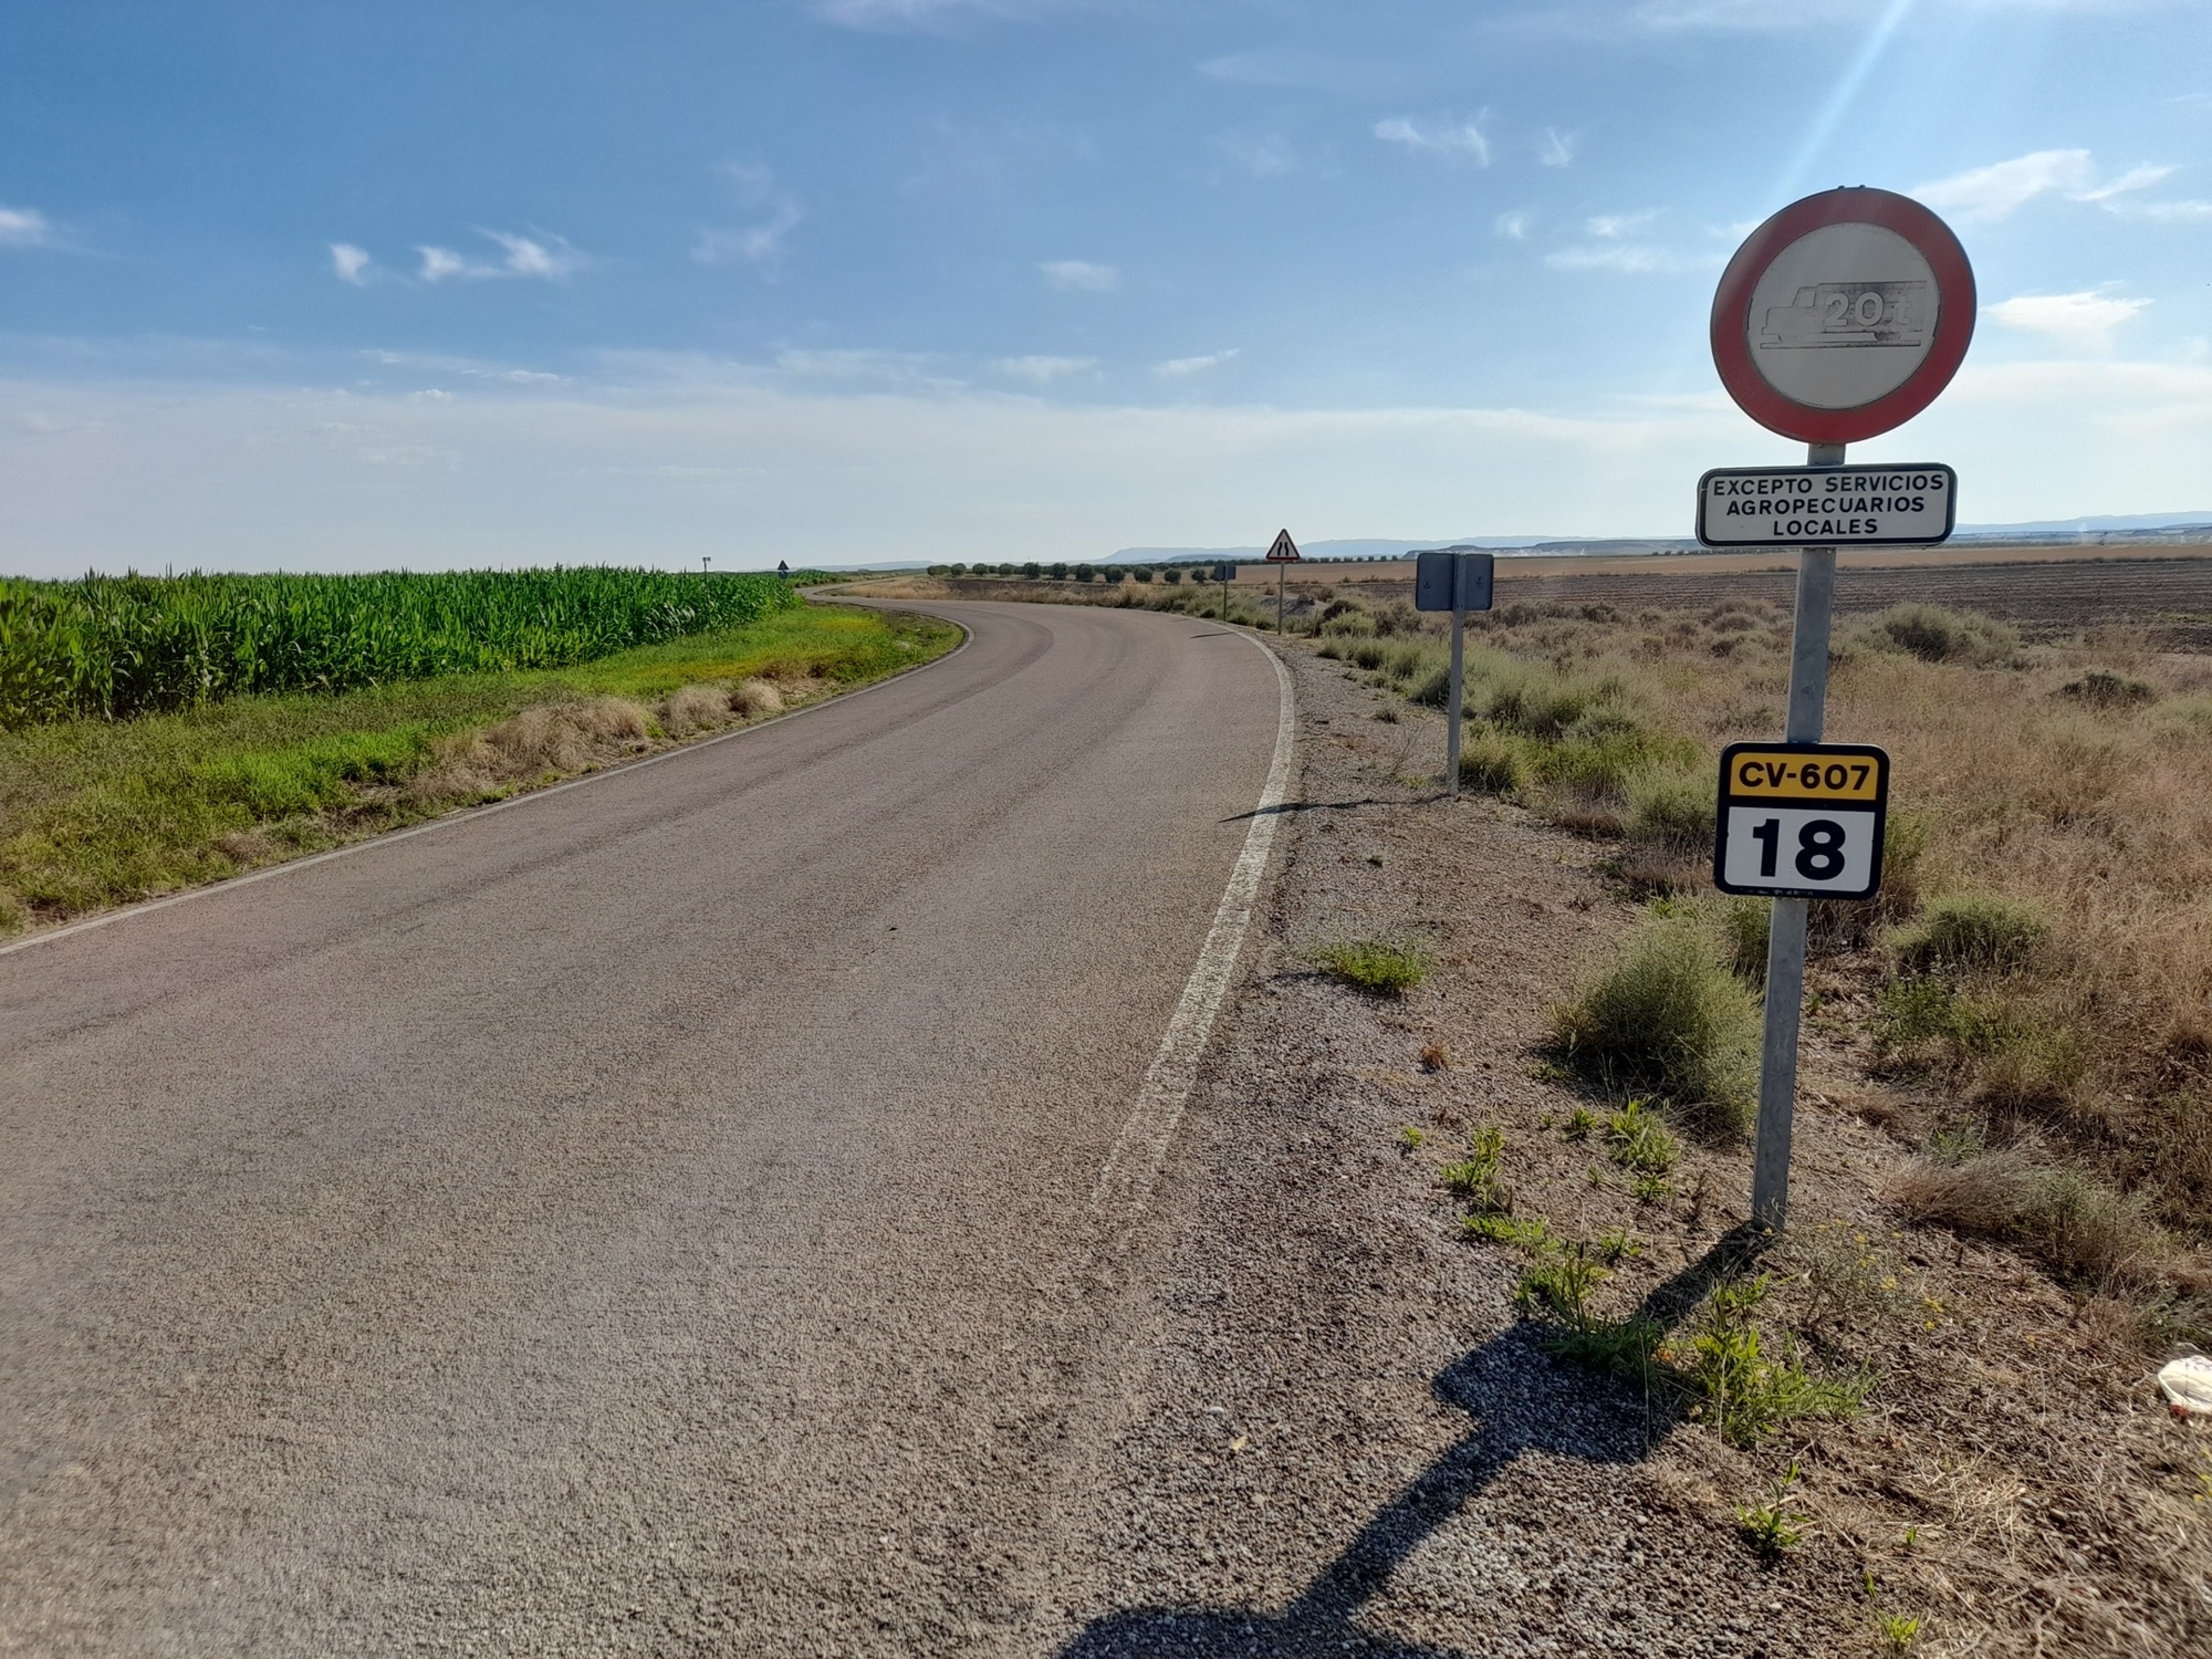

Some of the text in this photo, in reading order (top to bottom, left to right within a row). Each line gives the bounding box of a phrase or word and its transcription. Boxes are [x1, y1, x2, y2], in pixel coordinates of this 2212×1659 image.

[1824, 292, 1883, 326] 20
[1714, 474, 1944, 495] EXCEPTO SERVICIOS
[1726, 497, 1925, 516] AGROPECUARIOS
[1774, 518, 1878, 536] LOCALES
[1739, 762, 1870, 790] CV-607
[1752, 818, 1846, 881] 18
